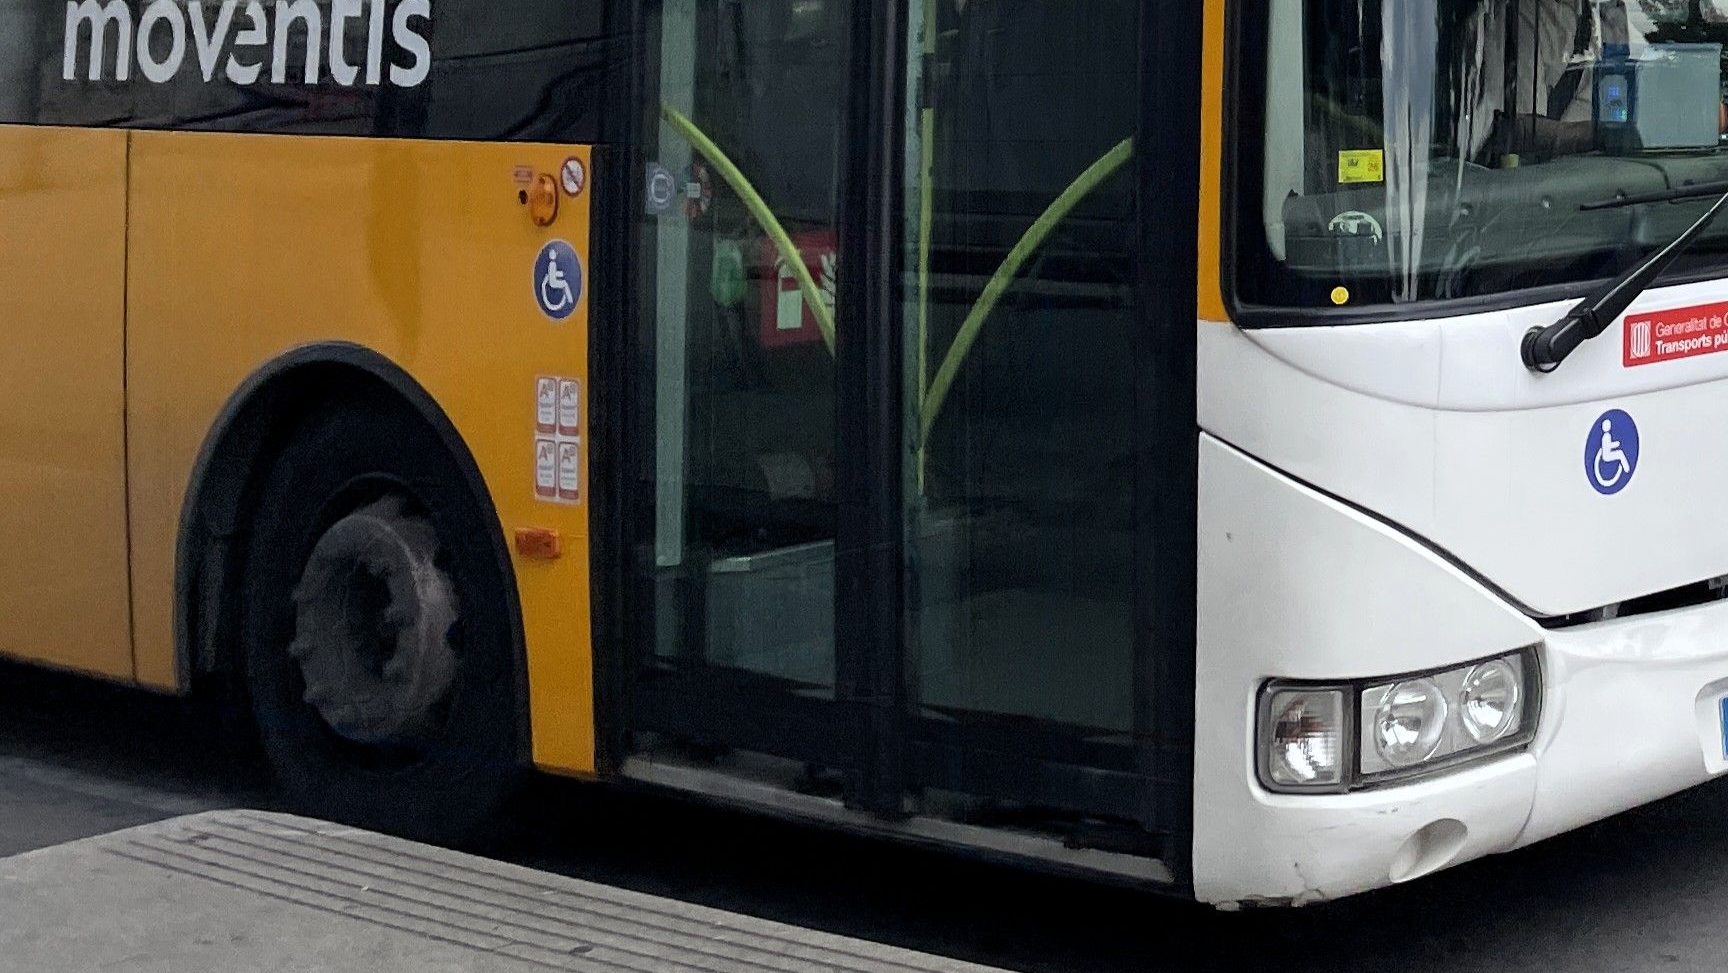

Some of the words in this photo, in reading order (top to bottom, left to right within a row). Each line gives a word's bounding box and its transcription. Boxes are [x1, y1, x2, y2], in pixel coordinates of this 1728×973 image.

[1656, 316, 1707, 337] Generalitat
[1709, 315, 1722, 328] de
[1655, 335, 1712, 355] Transports
